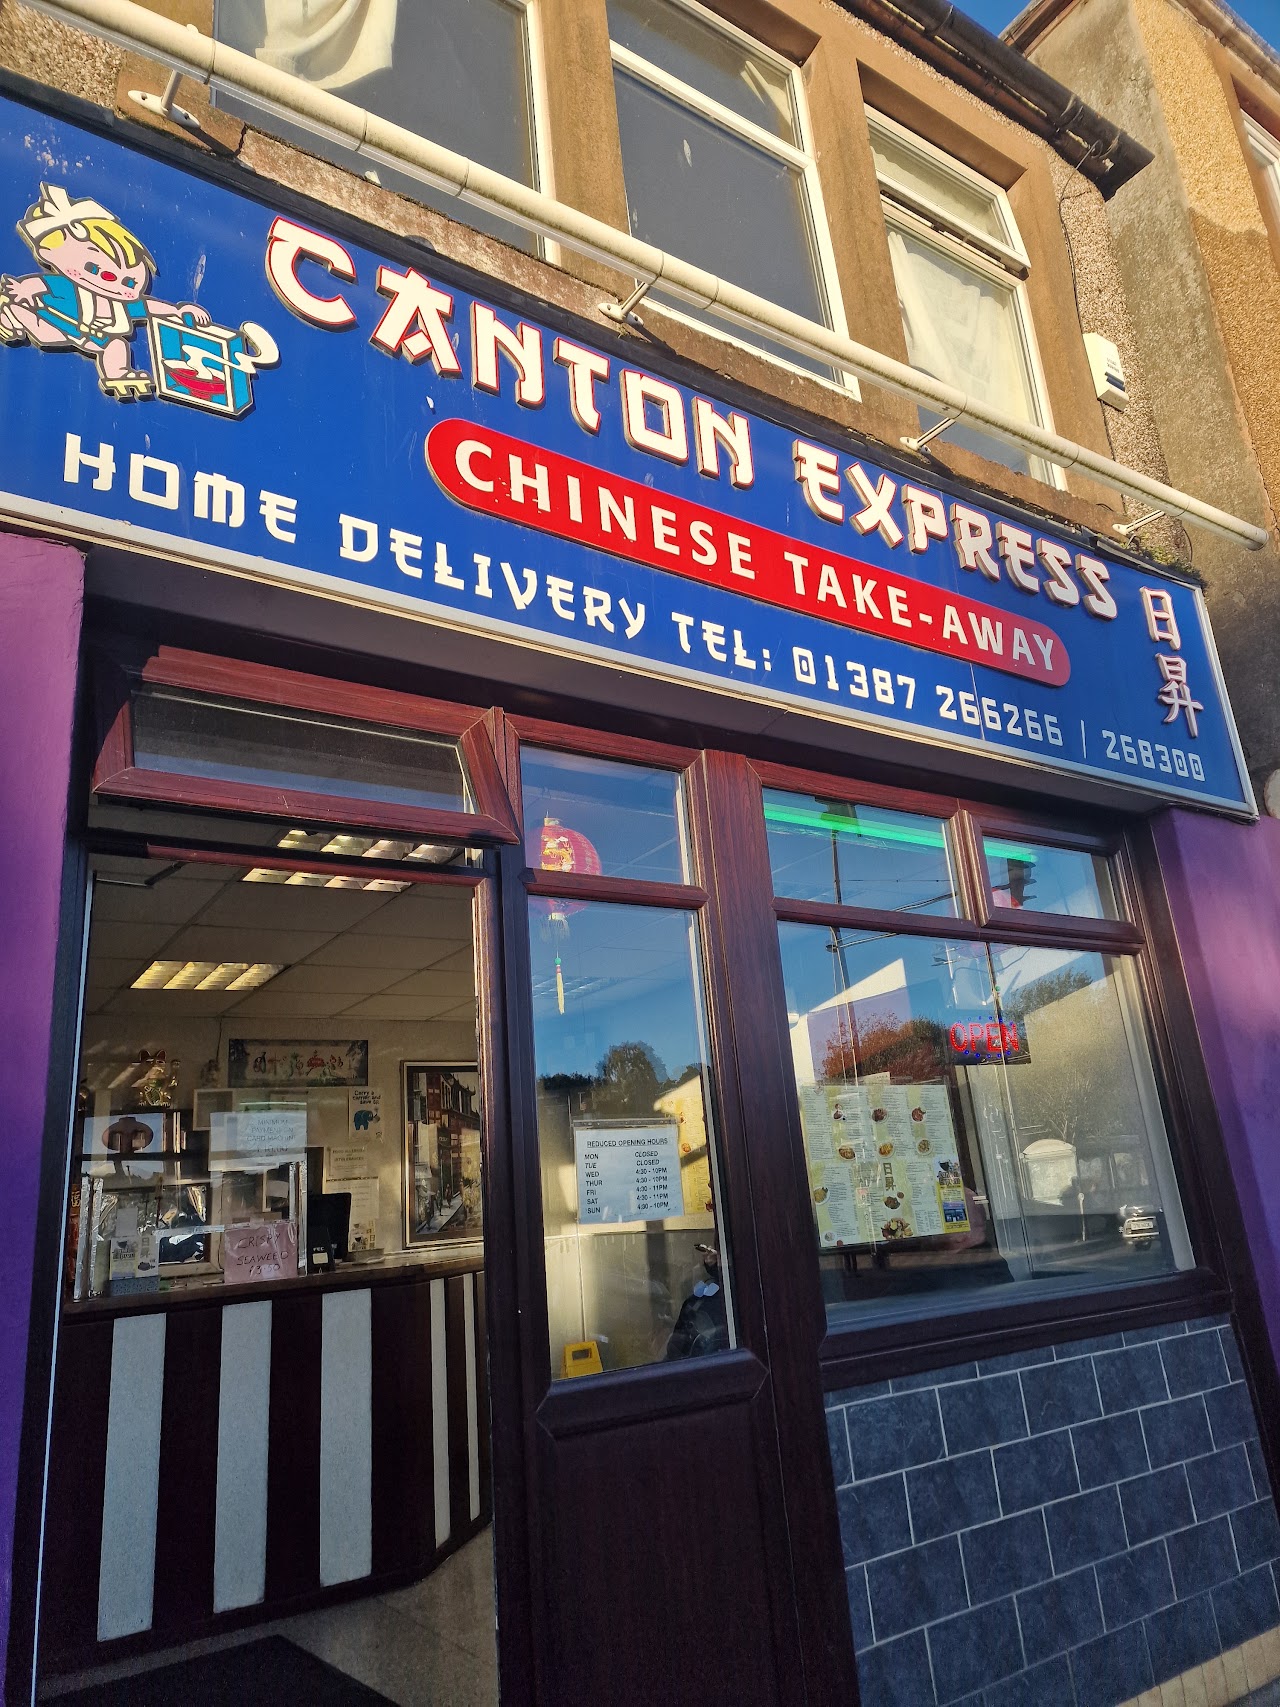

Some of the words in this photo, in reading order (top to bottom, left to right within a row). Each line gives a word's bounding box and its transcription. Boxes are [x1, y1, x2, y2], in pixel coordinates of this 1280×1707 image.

[265, 216, 755, 490] CANTON
[792, 438, 1118, 622] EXPRESS
[455, 439, 756, 581] CHINESE
[783, 552, 1054, 671] TAKE-AWAY
[63, 432, 298, 544] HOME
[338, 513, 647, 640] DELIVERY
[671, 611, 772, 672] TEL:
[792, 646, 916, 710] 01387
[936, 685, 1064, 747] 266266
[1102, 730, 1206, 782] 268300
[1139, 586, 1204, 738] 日昇
[950, 1022, 1020, 1052] OPEN
[586, 1140, 617, 1148] REDUCED
[618, 1139, 646, 1147] OPENING
[236, 1250, 289, 1266] SEAWEED
[238, 1233, 281, 1249] CRISPY
